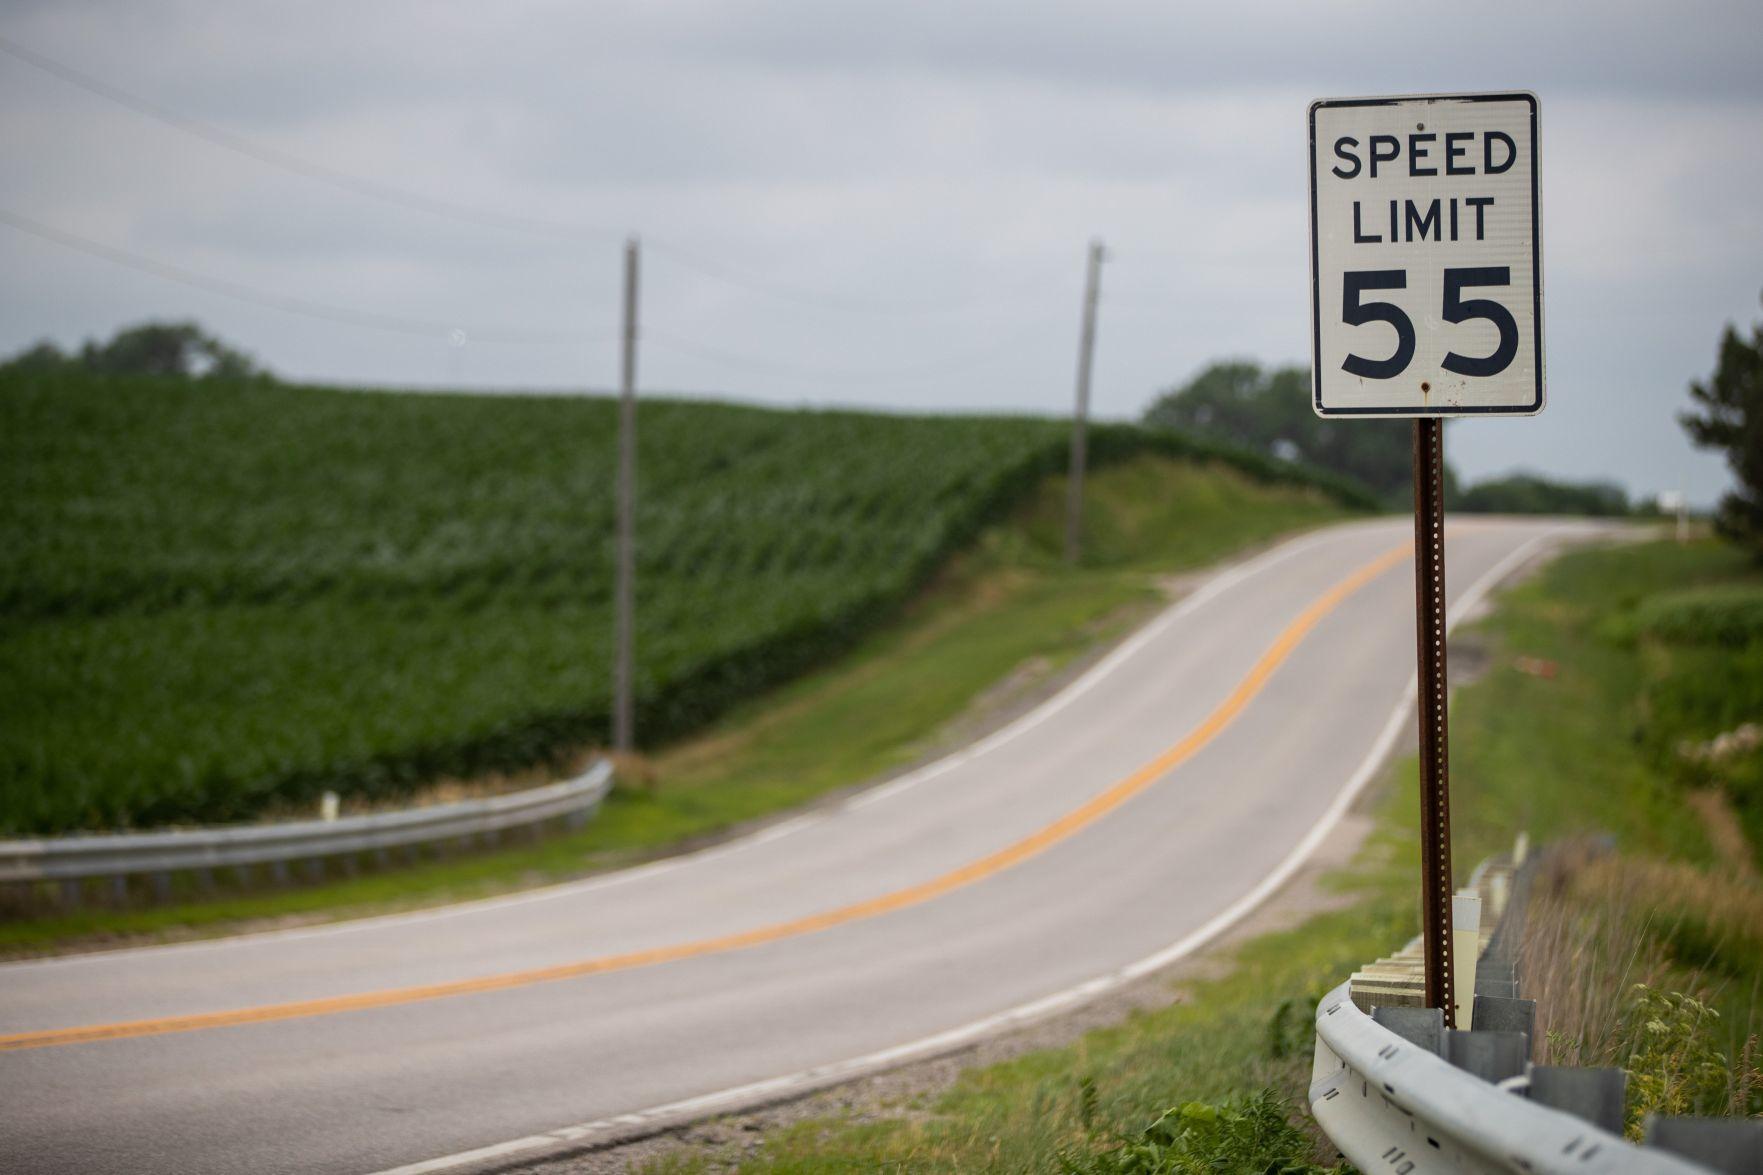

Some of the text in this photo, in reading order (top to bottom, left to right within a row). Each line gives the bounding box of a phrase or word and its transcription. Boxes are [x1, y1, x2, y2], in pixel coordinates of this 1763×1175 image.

[1332, 131, 1517, 180] SPEED
[1353, 197, 1495, 244] LIMIT
[1341, 266, 1519, 380] 55
